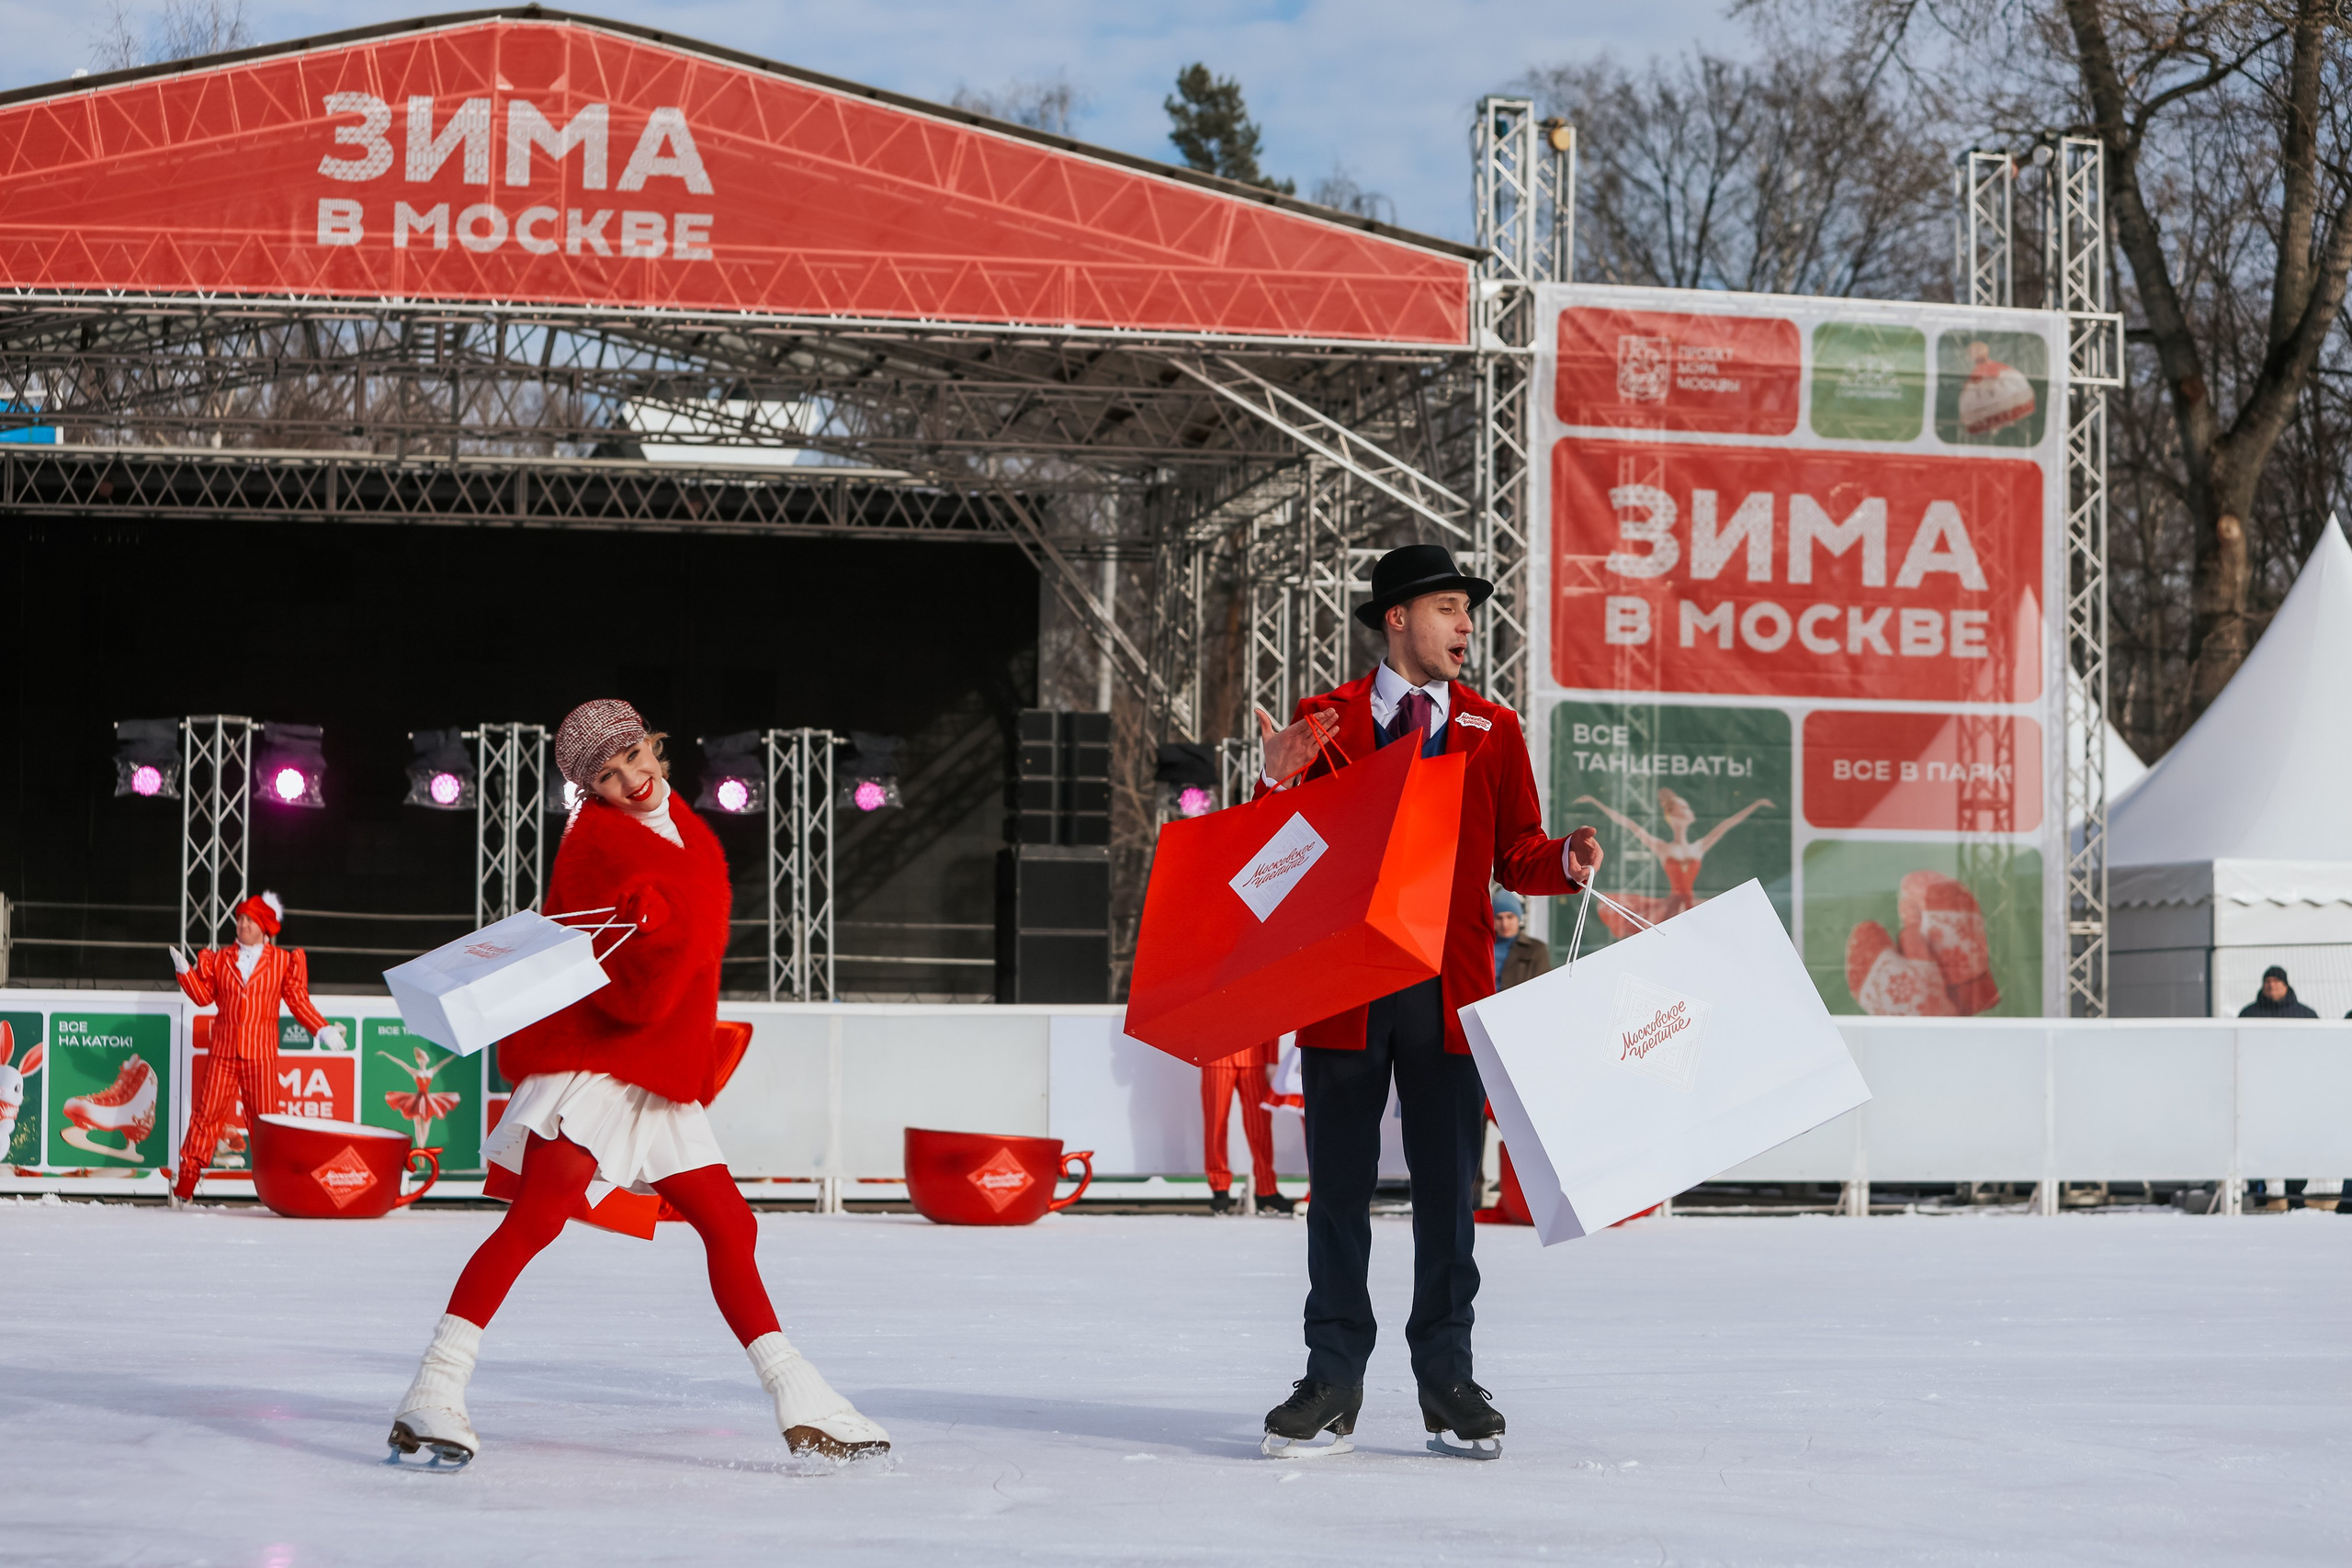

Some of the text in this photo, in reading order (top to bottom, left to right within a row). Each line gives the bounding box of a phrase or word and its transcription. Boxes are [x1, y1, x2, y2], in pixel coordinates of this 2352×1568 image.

[317, 91, 715, 196] ЗИМА
[317, 197, 715, 261] В МОСКВЕ
[1604, 483, 1990, 592] ЗИМА
[1604, 595, 1990, 659] В МОСКВЕ
[1572, 723, 1630, 747] ВСЕ
[1572, 750, 1753, 777] ТАНЦЕВАТЬ!
[1833, 759, 1892, 781] ВСЕ
[1900, 761, 1918, 782] В
[1242, 840, 1317, 888] Московское
[58, 1021, 88, 1033] ВСЕ
[58, 1034, 133, 1048] НА КАТОК!
[378, 1025, 400, 1035] ВСЕ
[1620, 1000, 1687, 1061] Московское
[1629, 1015, 1691, 1059] чаепитие
